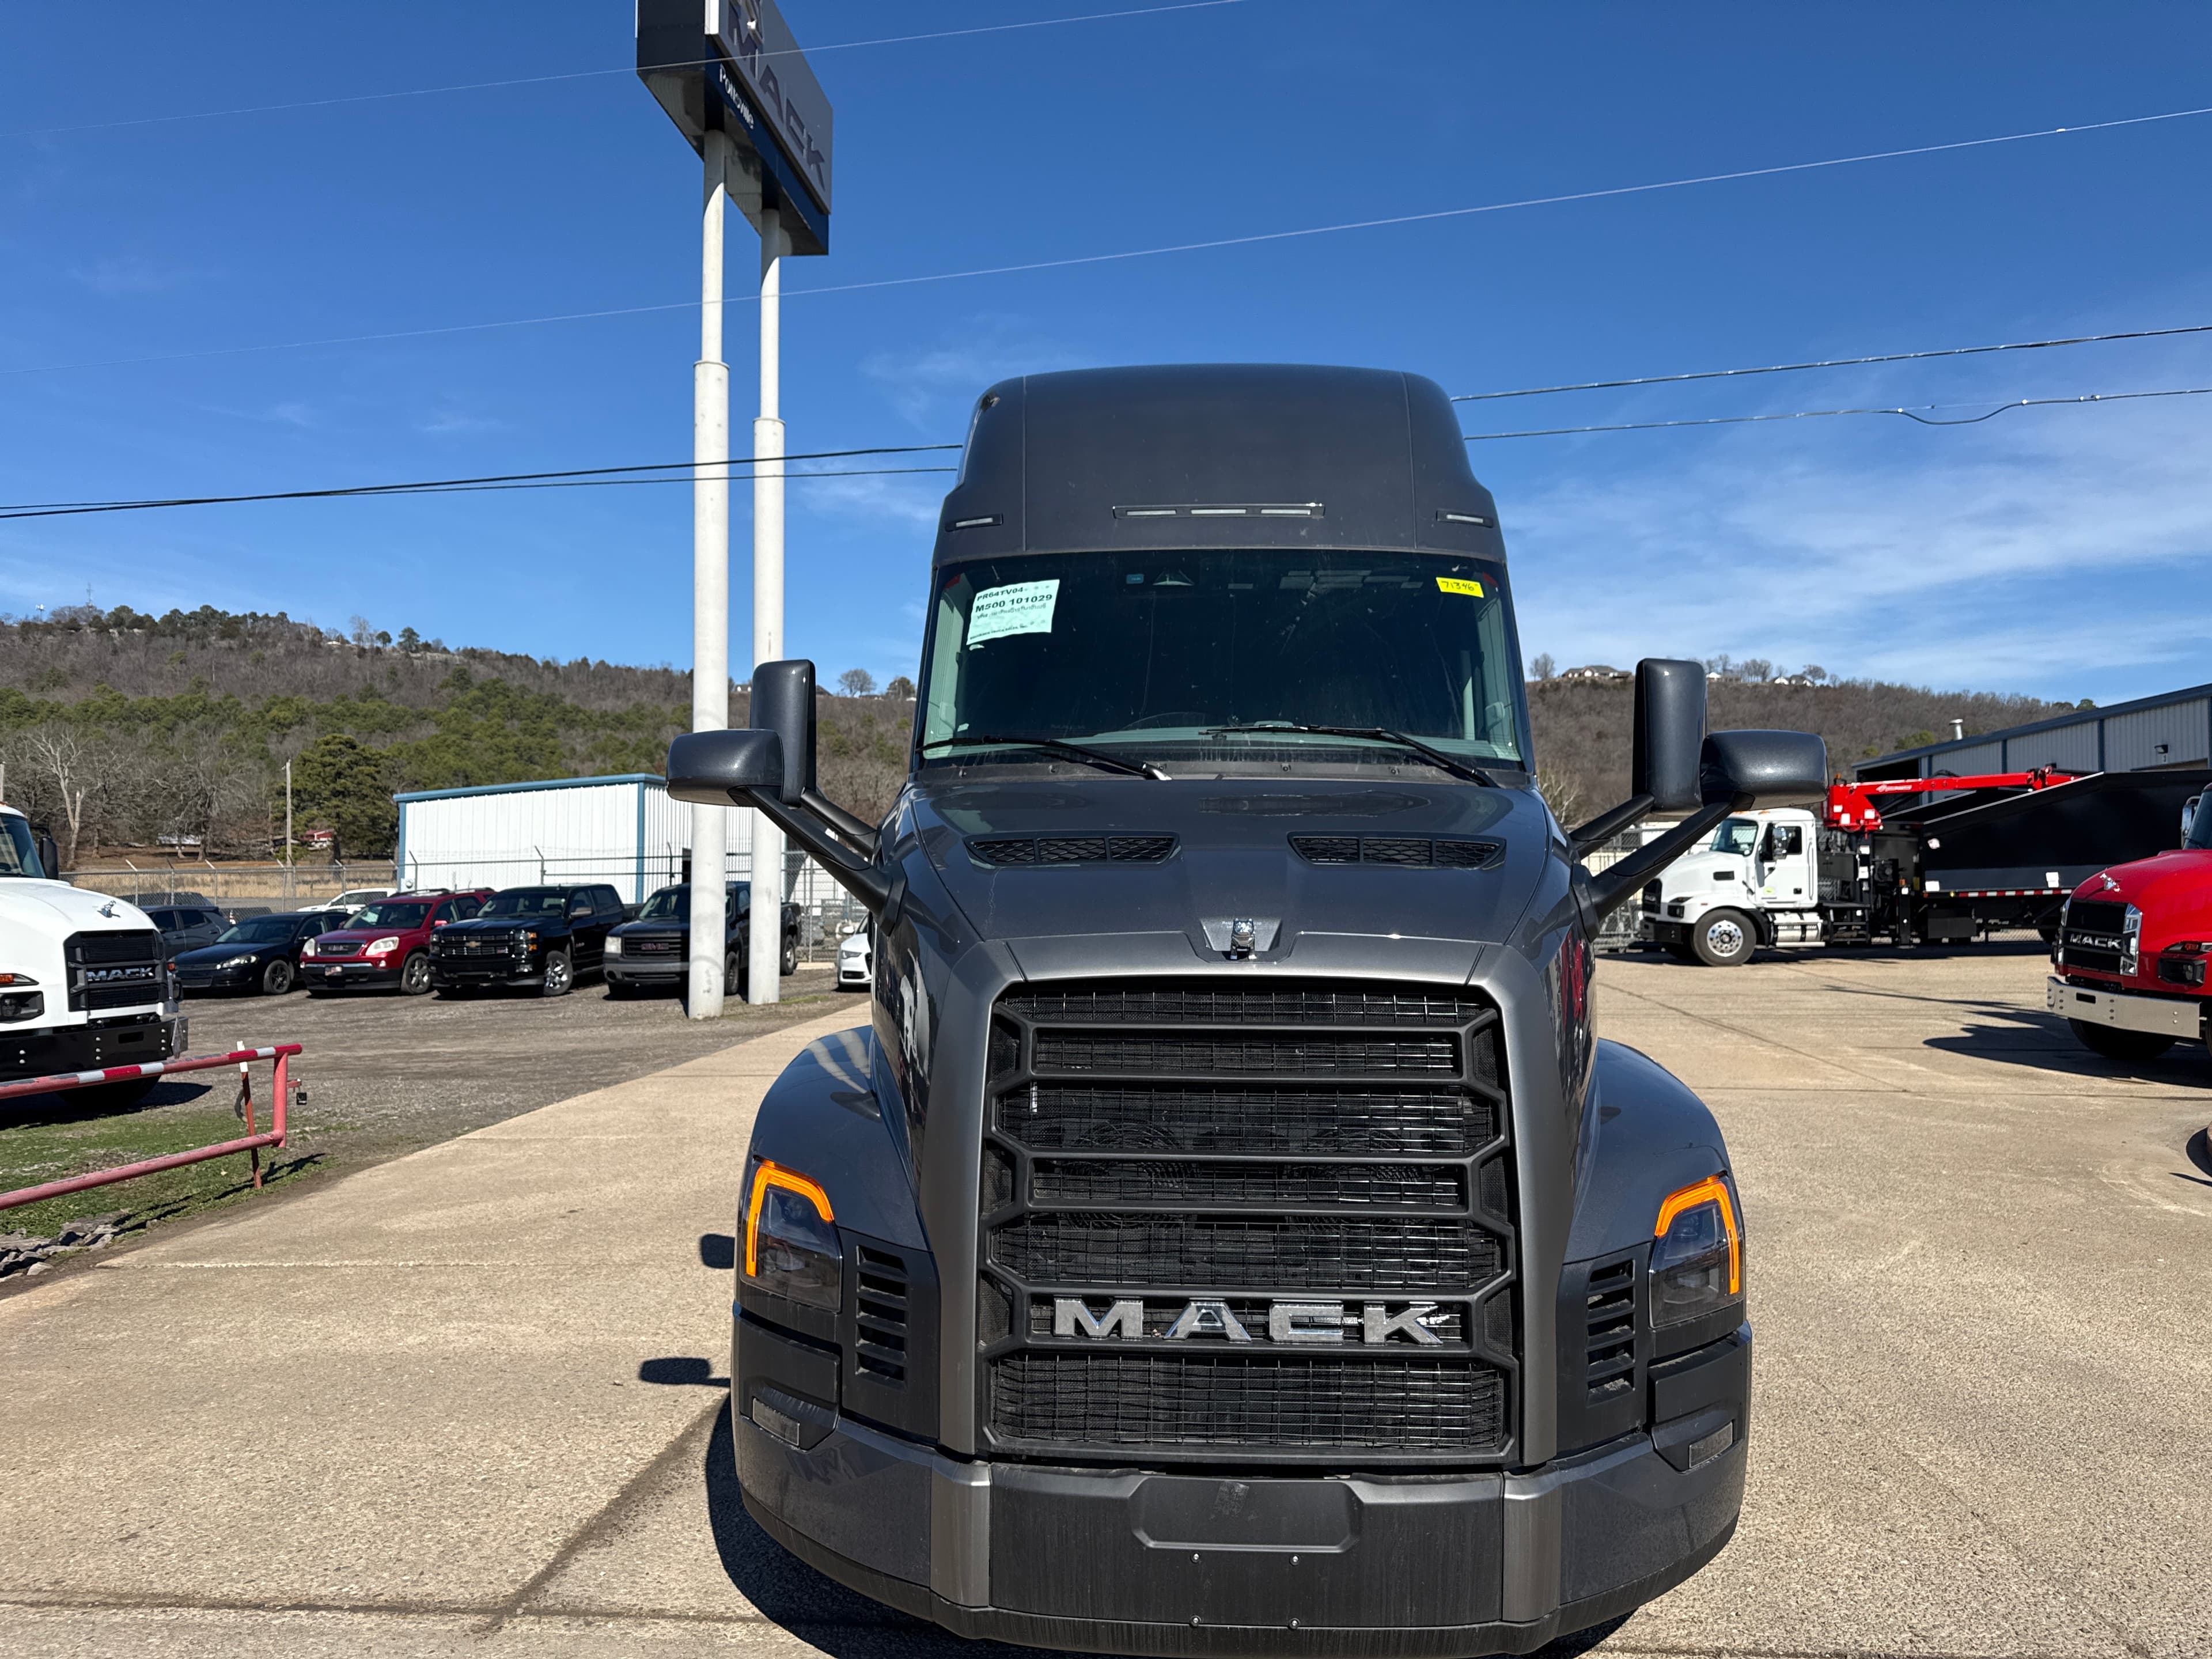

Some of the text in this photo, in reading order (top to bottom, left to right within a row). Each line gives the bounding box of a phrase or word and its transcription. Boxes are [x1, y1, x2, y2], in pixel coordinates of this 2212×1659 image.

[728, 0, 825, 192] MACK
[975, 600, 1006, 613] M500
[1009, 594, 1053, 605] 101029
[2070, 934, 2121, 949] MACK
[86, 967, 154, 982] MACK
[1054, 1298, 1443, 1344] MACK
